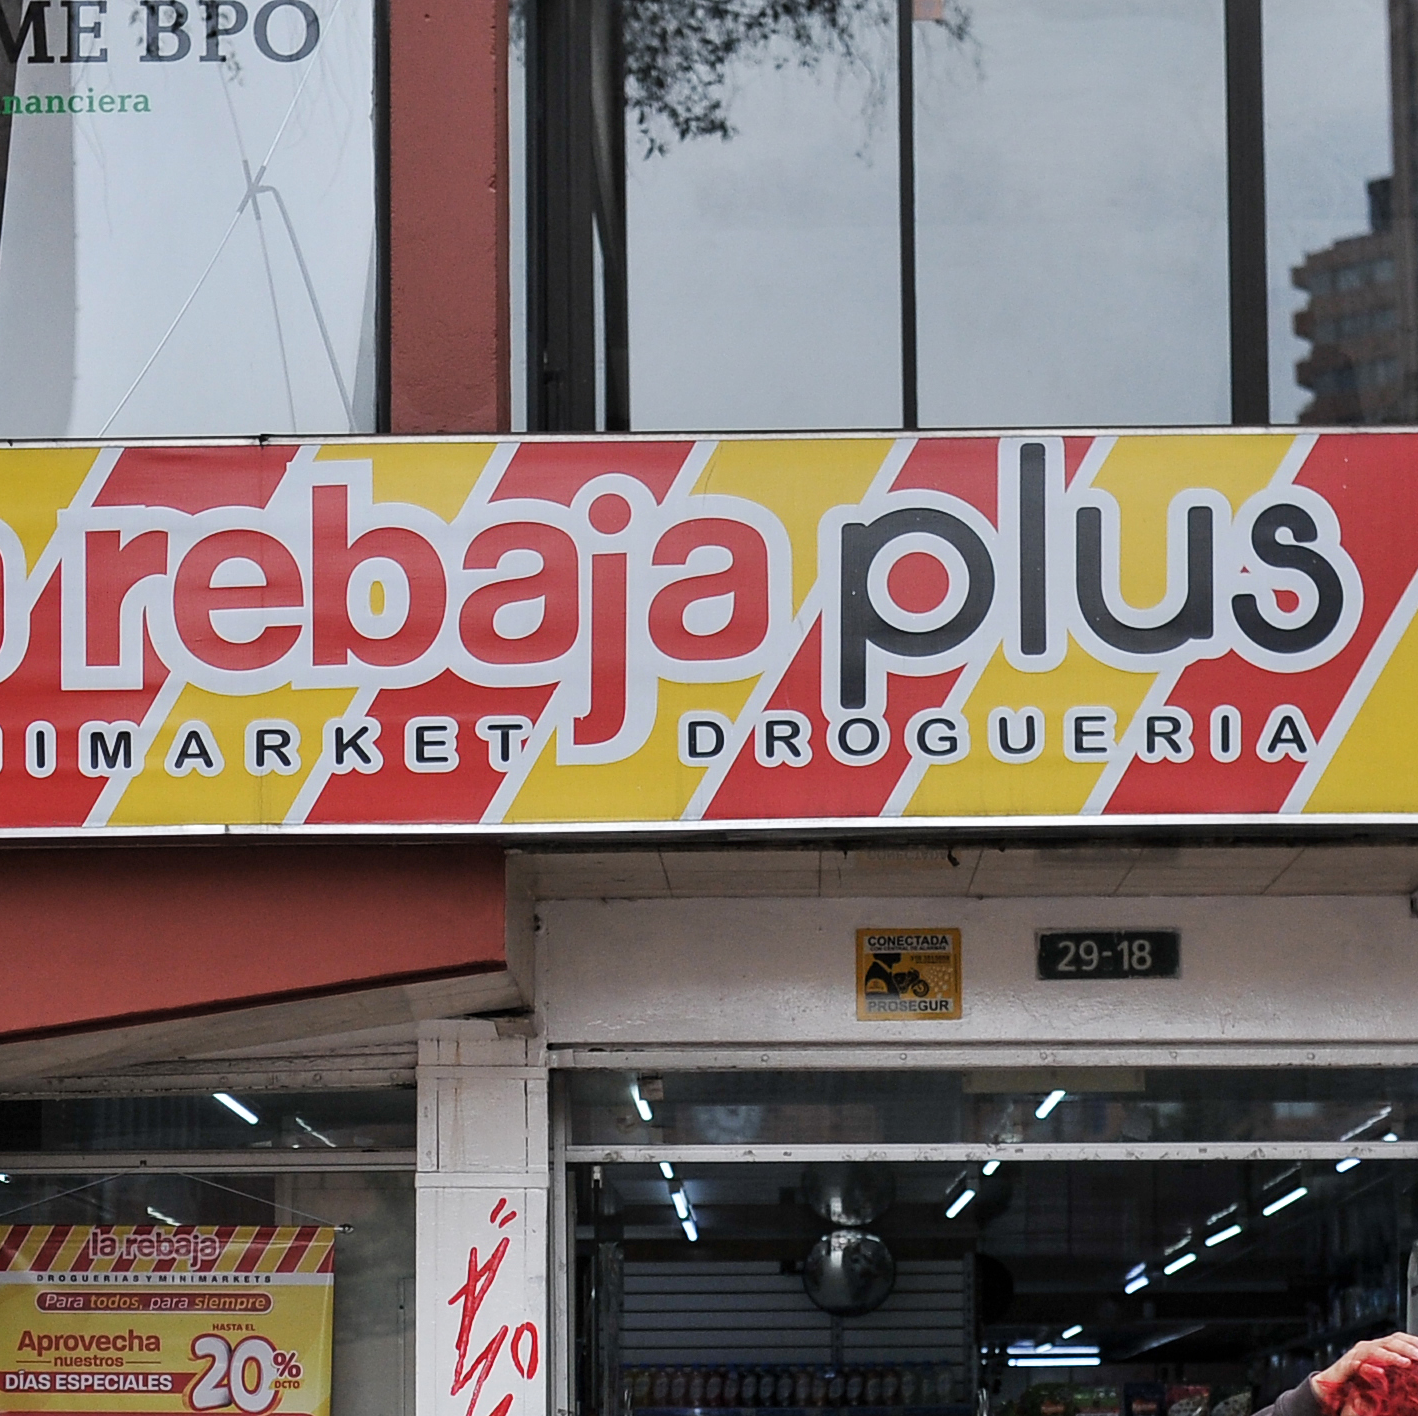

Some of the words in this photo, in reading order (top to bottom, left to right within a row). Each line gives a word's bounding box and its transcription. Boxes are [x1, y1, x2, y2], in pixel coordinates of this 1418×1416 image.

[140, 0, 320, 62] BPO
[83, 482, 769, 747] rebaja
[840, 443, 1344, 709] plus
[687, 714, 1309, 758] DROGUERIA
[867, 935, 949, 947] CONECTADA
[1056, 939, 1152, 973] 29-18
[867, 1000, 949, 1012] PROSEGUR
[91, 1230, 116, 1257] la
[123, 1230, 220, 1269] rebaja
[37, 1274, 140, 1283] DROGUERIAS
[158, 1274, 272, 1284] MINIMARKETS
[45, 1294, 84, 1309] Para
[89, 1293, 143, 1310] todos,
[149, 1297, 188, 1311] para
[194, 1296, 266, 1311] siempre
[212, 1322, 239, 1332] HASTA
[243, 1323, 256, 1332] EL
[17, 1329, 161, 1355] Aprovecha
[53, 1354, 124, 1367] nuestros
[5, 1369, 51, 1391] DÍAS
[54, 1374, 173, 1391] ESPECIALES
[273, 1380, 301, 1389] DCTO
